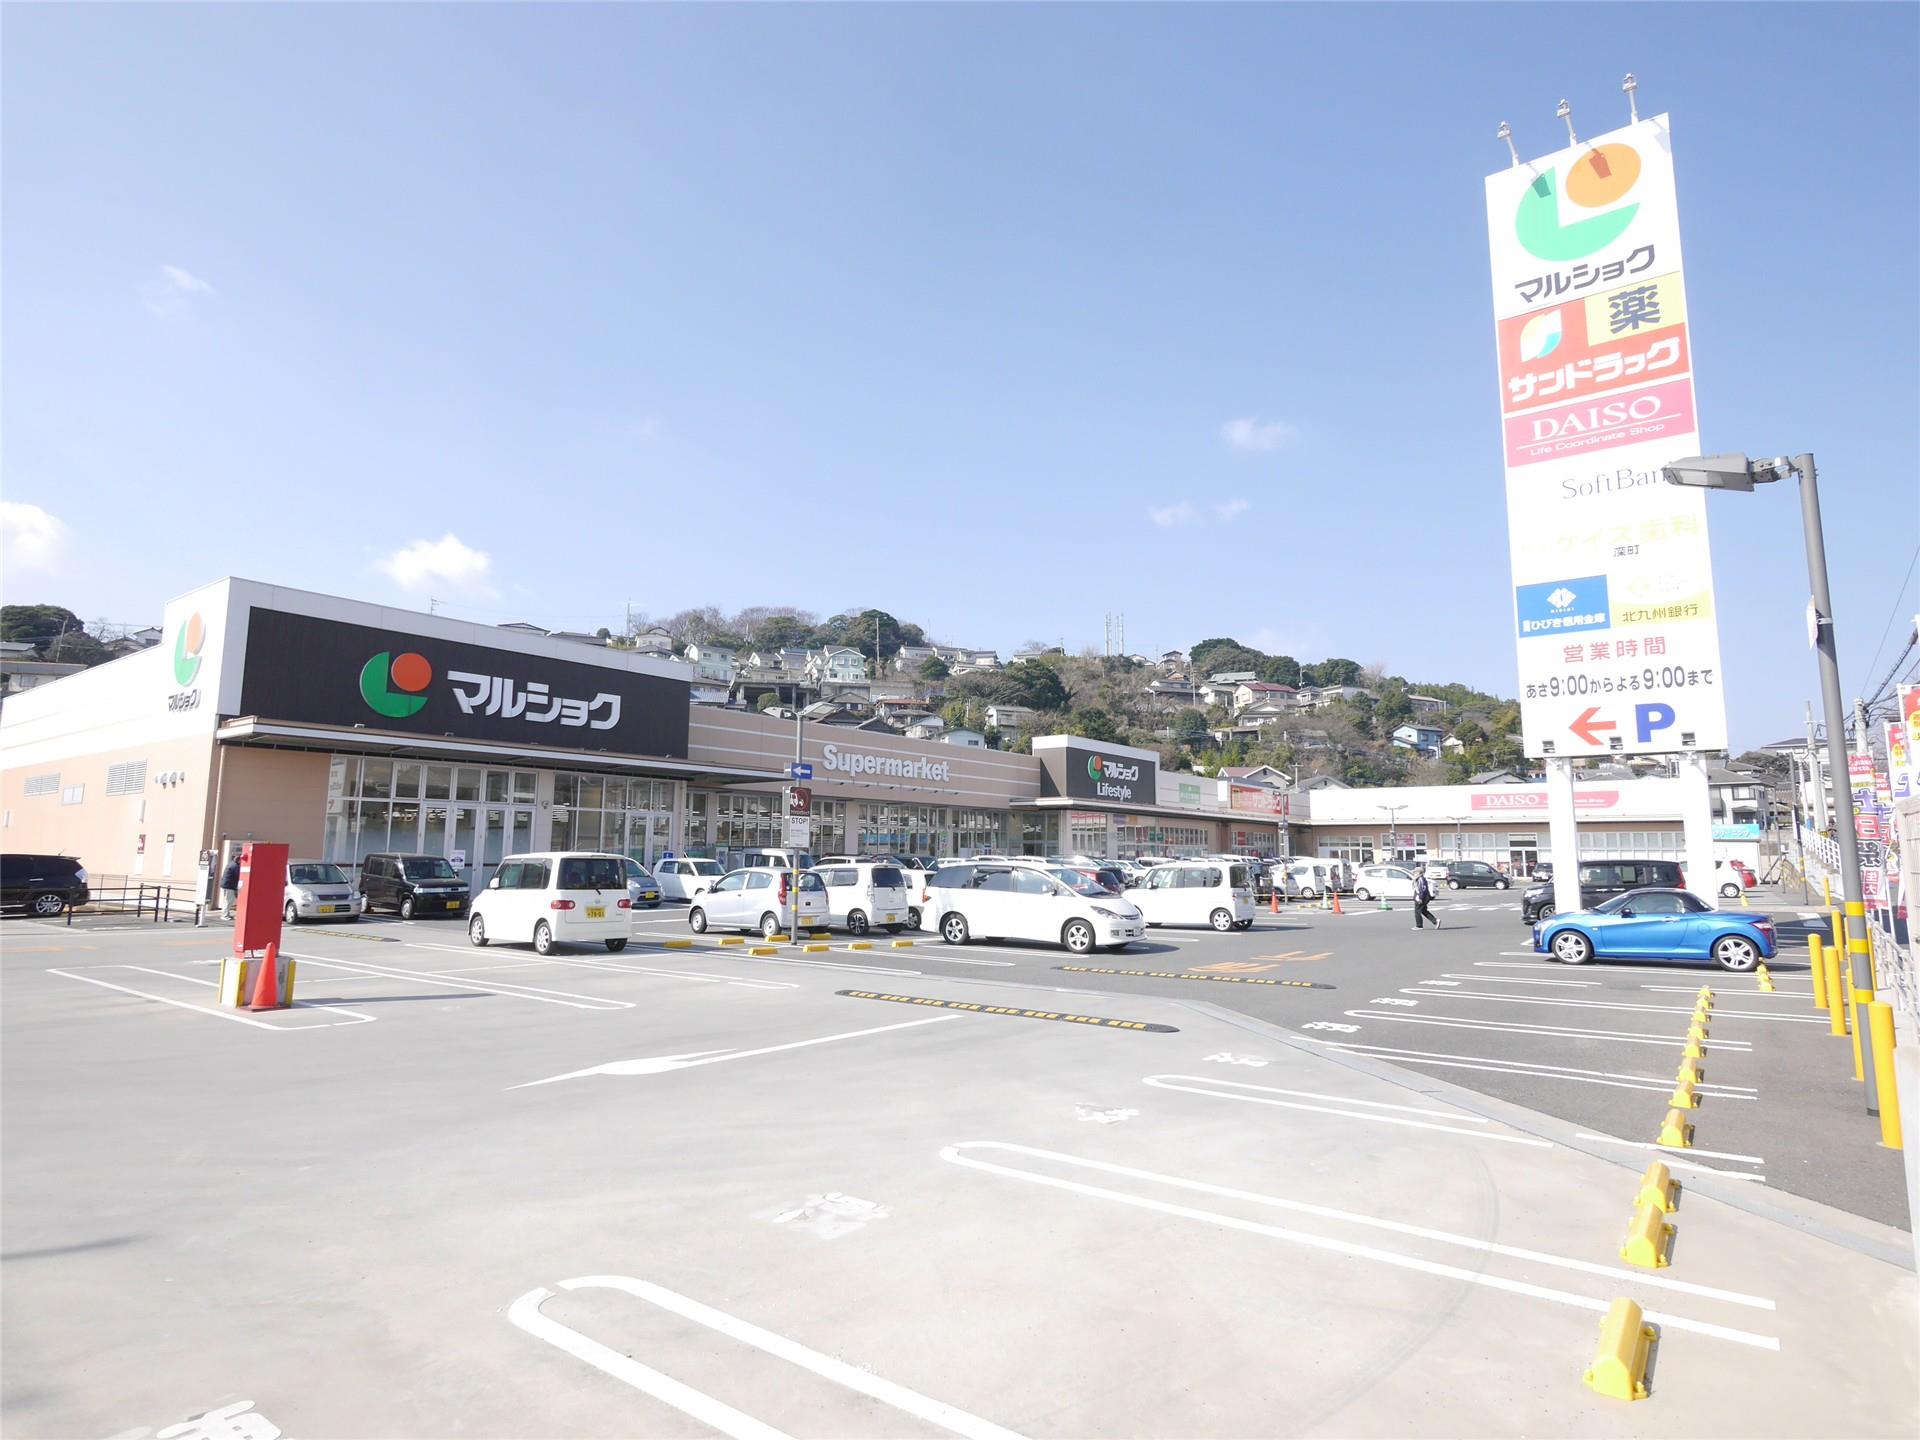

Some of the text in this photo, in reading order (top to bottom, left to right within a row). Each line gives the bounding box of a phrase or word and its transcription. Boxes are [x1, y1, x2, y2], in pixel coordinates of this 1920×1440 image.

[1514, 244, 1655, 303] マルショク
[1608, 284, 1661, 334] 薬
[1532, 396, 1661, 440] DAISO
[1530, 423, 1665, 456] Life Coordinate Shop
[1562, 467, 1666, 500] SoftBan
[1622, 604, 1699, 622] 北九州銀行
[1563, 636, 1667, 663] 営業時間
[447, 670, 621, 730] マルショク
[1635, 703, 1676, 743] P
[823, 744, 949, 781] Supermarket
[1102, 760, 1139, 781] マルショク
[1096, 782, 1132, 800] Lifestyle
[1486, 794, 1539, 807] DAISO
[791, 817, 809, 825] STOP!
